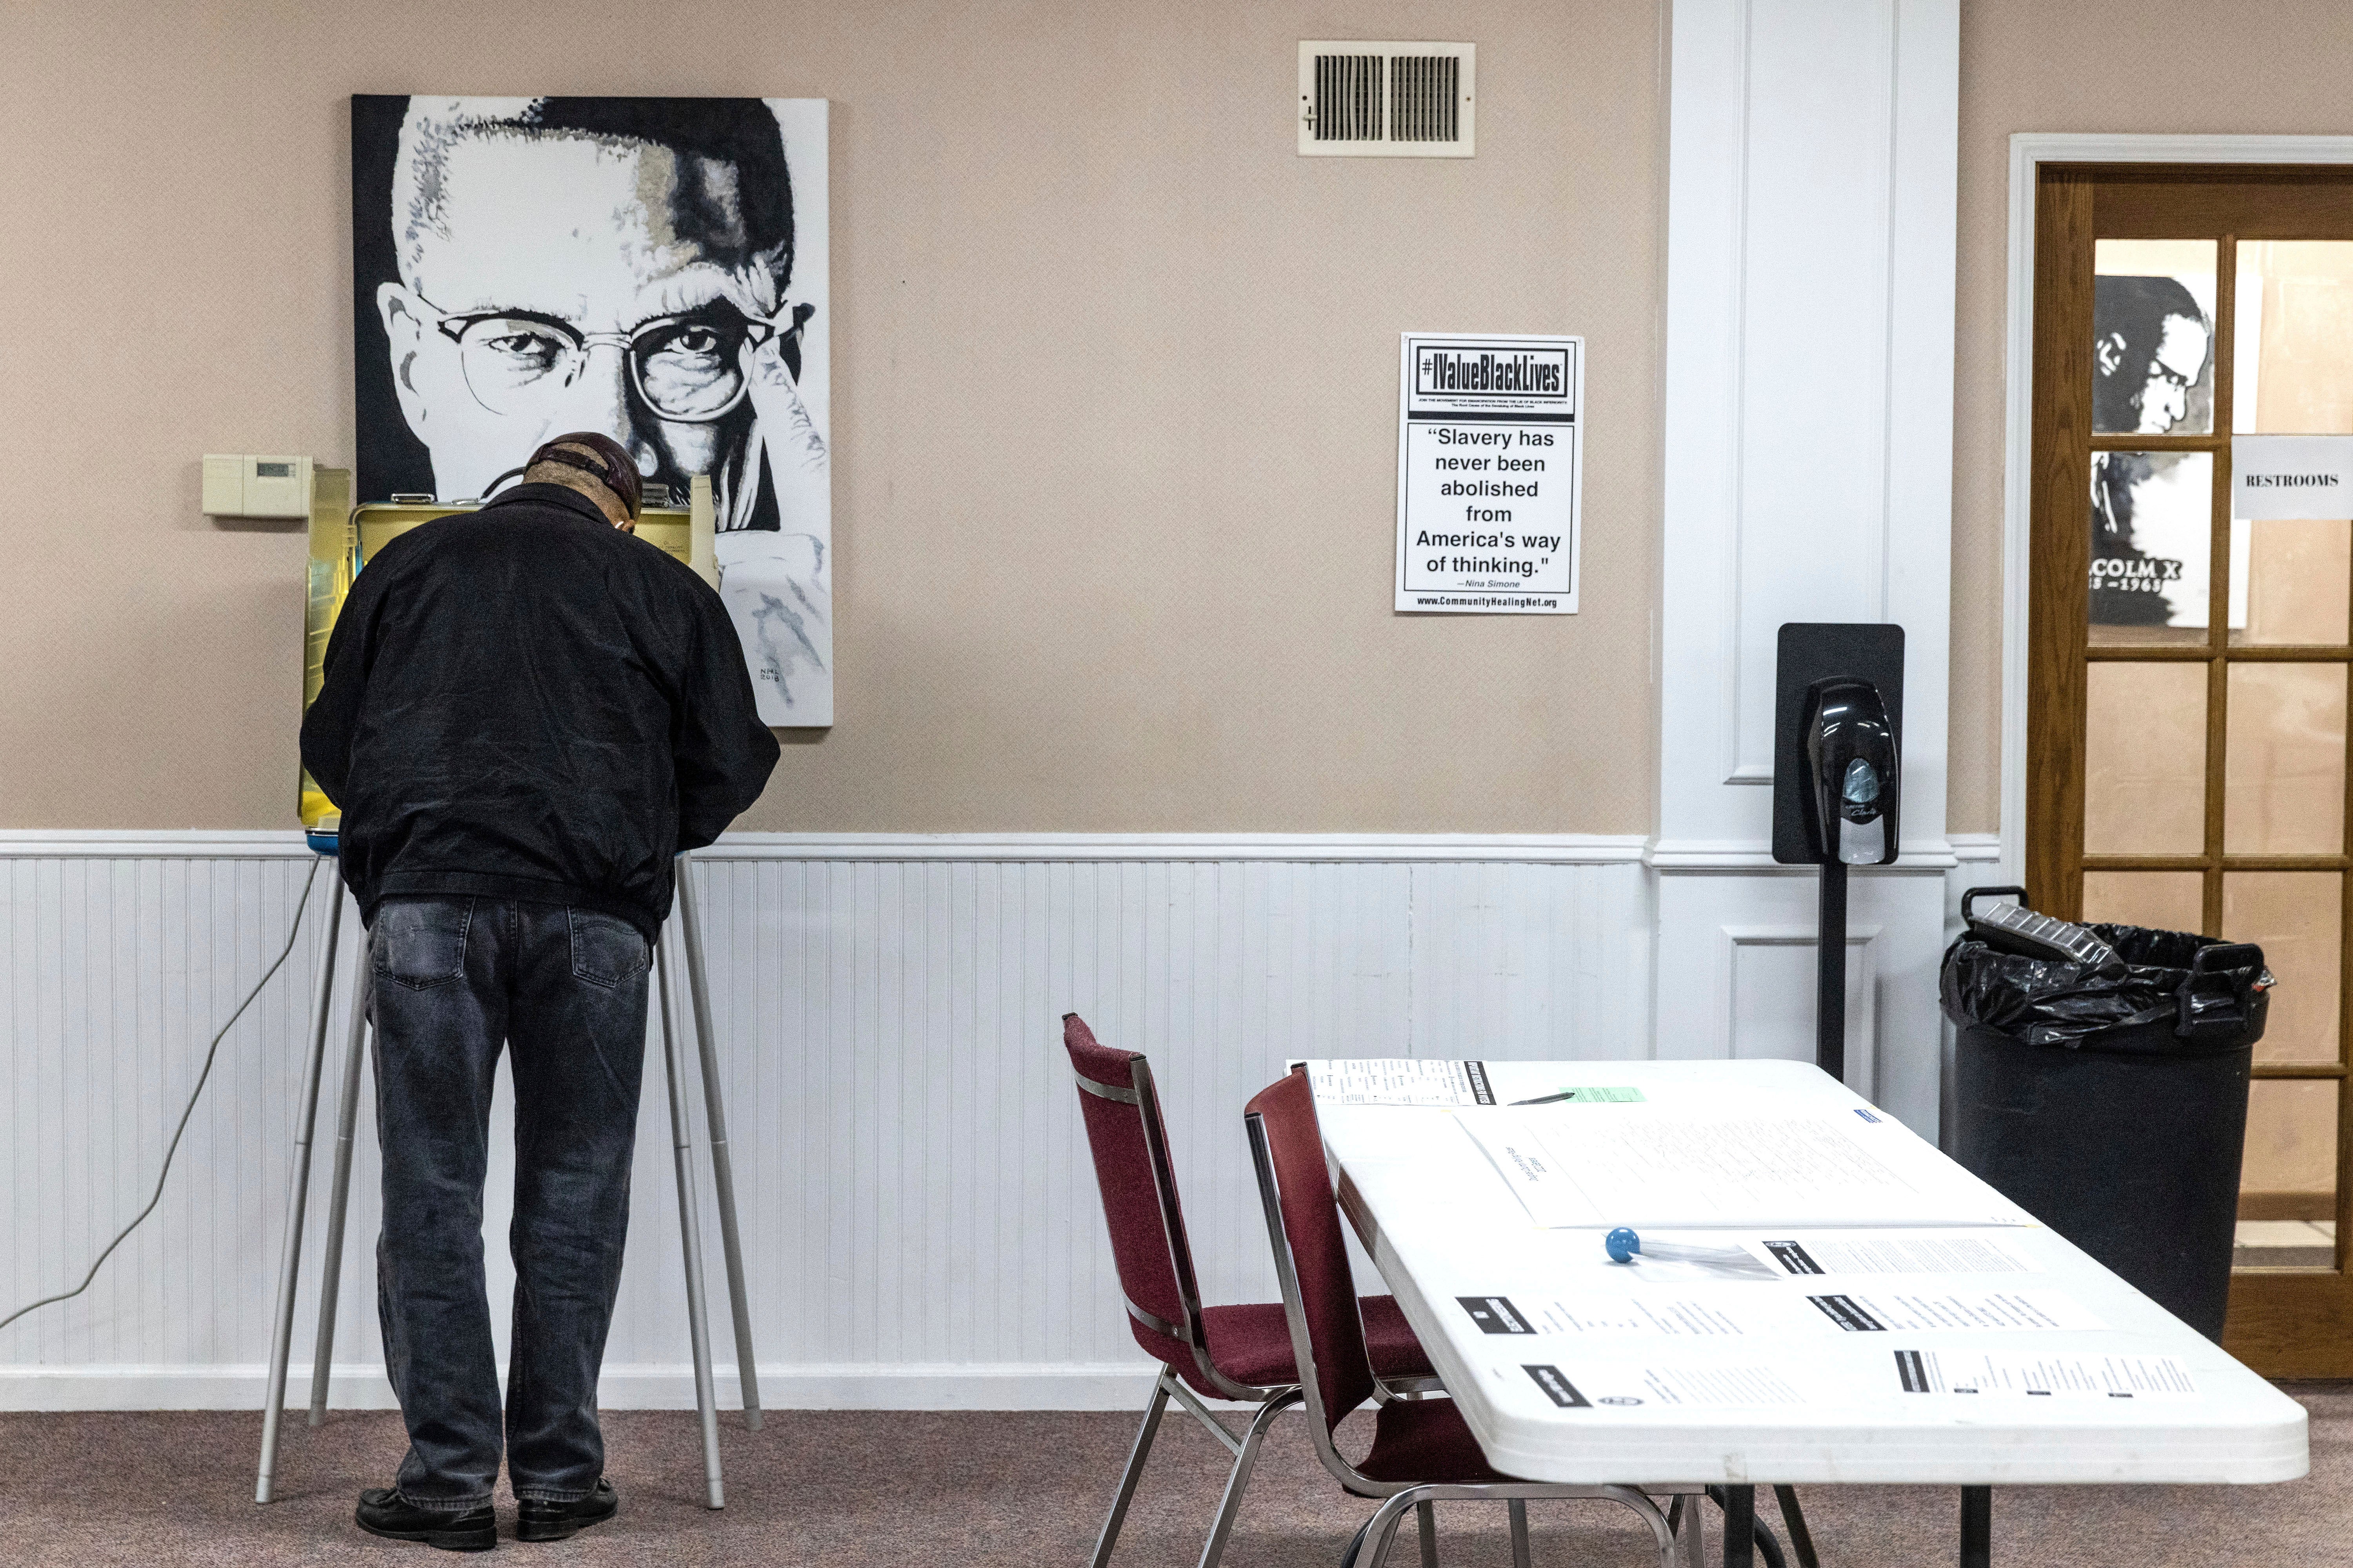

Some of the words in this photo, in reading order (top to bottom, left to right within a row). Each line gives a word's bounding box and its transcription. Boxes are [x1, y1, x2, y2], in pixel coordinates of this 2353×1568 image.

[1421, 354, 1559, 392] #IValueBlackLives
[1520, 431, 1553, 446] has
[1436, 458, 1491, 470] never
[1498, 456, 1544, 471] been
[1441, 480, 1538, 496] abolished
[2246, 474, 2338, 487] RESTROOMS
[1466, 506, 1511, 521] from
[1417, 531, 1515, 547] America's
[1522, 536, 1560, 552] way
[1427, 556, 1446, 571] of
[1453, 557, 1548, 577] thinking."
[2089, 558, 2157, 578] COLM
[2163, 561, 2178, 579] X
[1418, 597, 1557, 608] www.CommunityHealingNet.org
[1477, 1094, 1491, 1103] VOTERS
